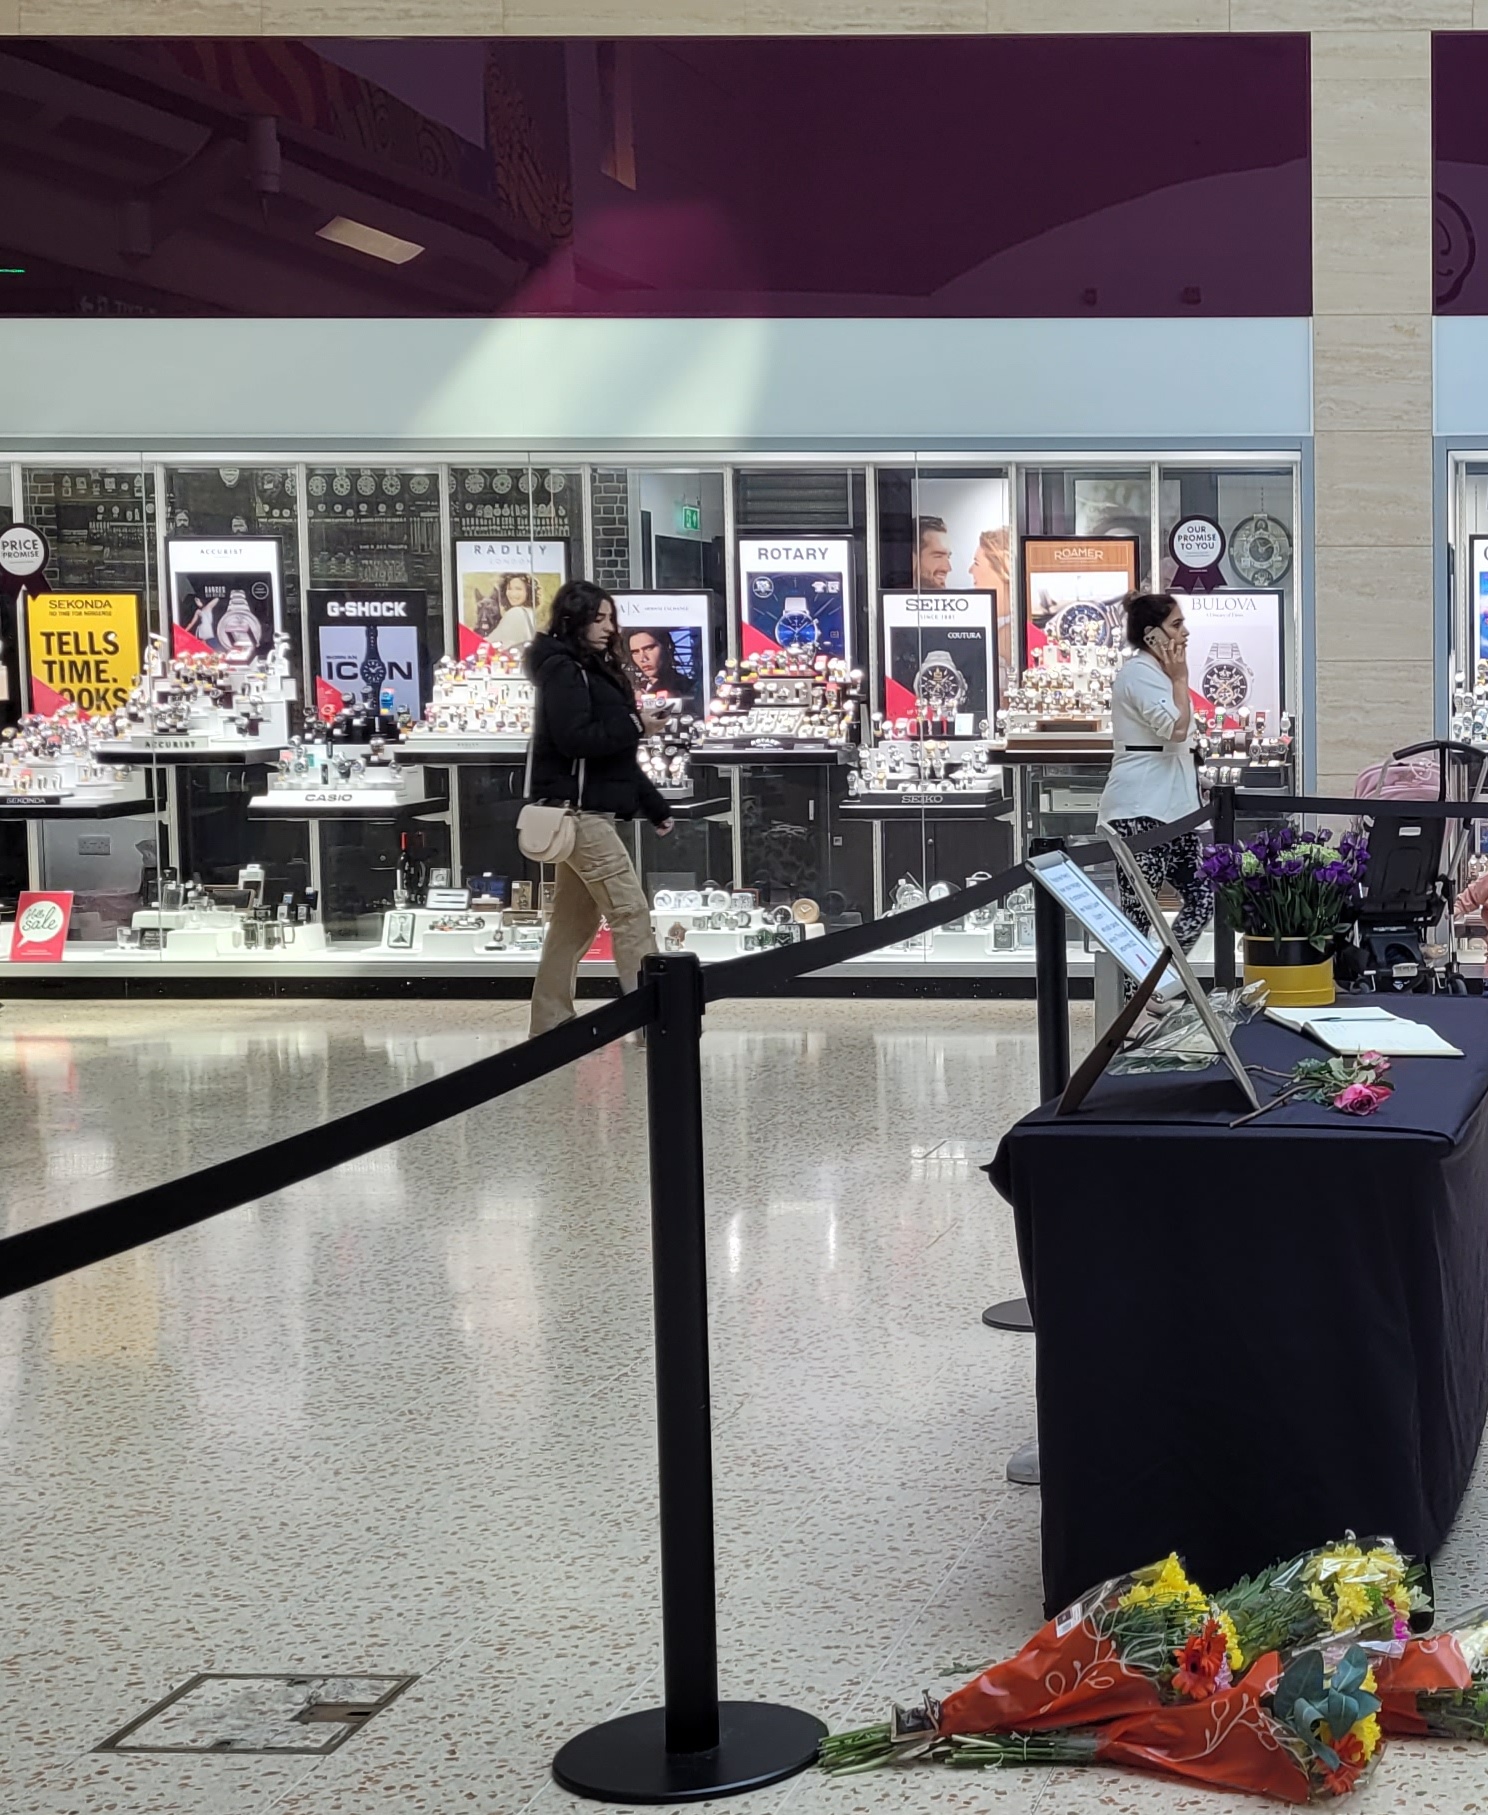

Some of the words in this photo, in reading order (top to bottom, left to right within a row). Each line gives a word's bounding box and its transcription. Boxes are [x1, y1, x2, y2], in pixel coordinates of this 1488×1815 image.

[1186, 525, 1207, 534] OUR
[1, 539, 39, 551] PRICE
[1177, 534, 1217, 543] PROMISE
[1181, 543, 1192, 551] TO
[1195, 542, 1215, 551] YOU
[2, 551, 40, 559] PROMISE
[757, 547, 829, 561] ROTARY
[1054, 547, 1104, 561] ROAMER
[48, 599, 113, 609] SEKONDA
[326, 601, 408, 617] G-SHOCK
[905, 598, 969, 612] SEIKO
[1191, 597, 1257, 611] BULOVA
[40, 630, 120, 656] TELLS
[41, 659, 119, 684] TIME.
[56, 686, 129, 712] OOKS
[144, 740, 196, 748] ACCURIST
[304, 793, 353, 802] CASIO
[901, 795, 943, 804] SEIKO
[22, 906, 59, 931] sale
